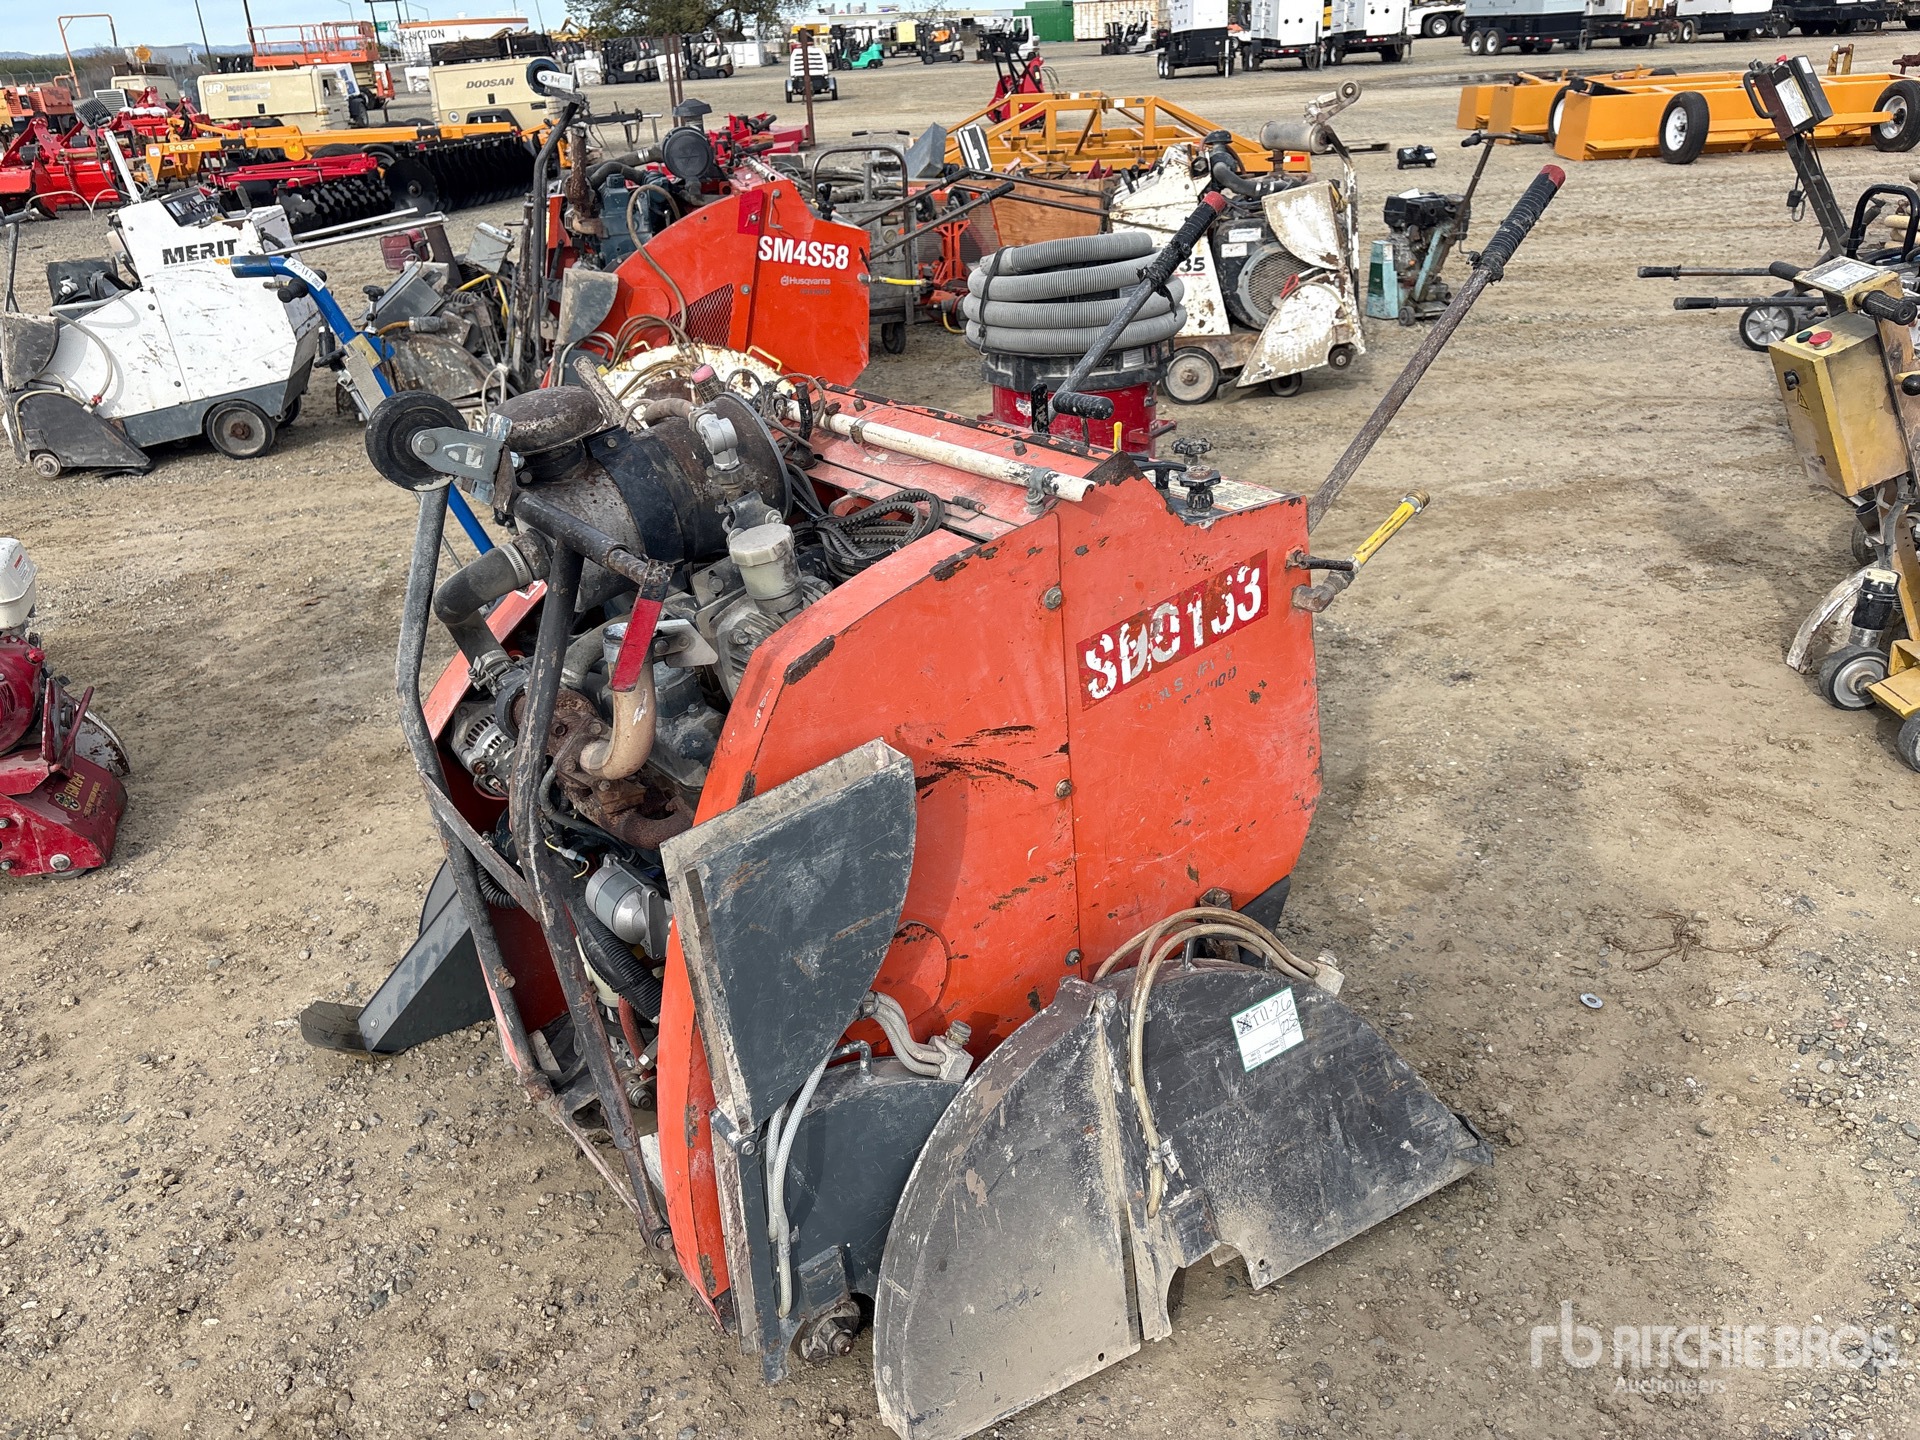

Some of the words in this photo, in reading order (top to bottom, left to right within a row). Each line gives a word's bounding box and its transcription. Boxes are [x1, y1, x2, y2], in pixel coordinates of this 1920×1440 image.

[466, 78, 514, 88] DOOSAN
[168, 143, 196, 152] 2424
[162, 239, 237, 265] MERIT
[758, 235, 850, 270] SM4S58
[789, 276, 831, 286] Husqvarna
